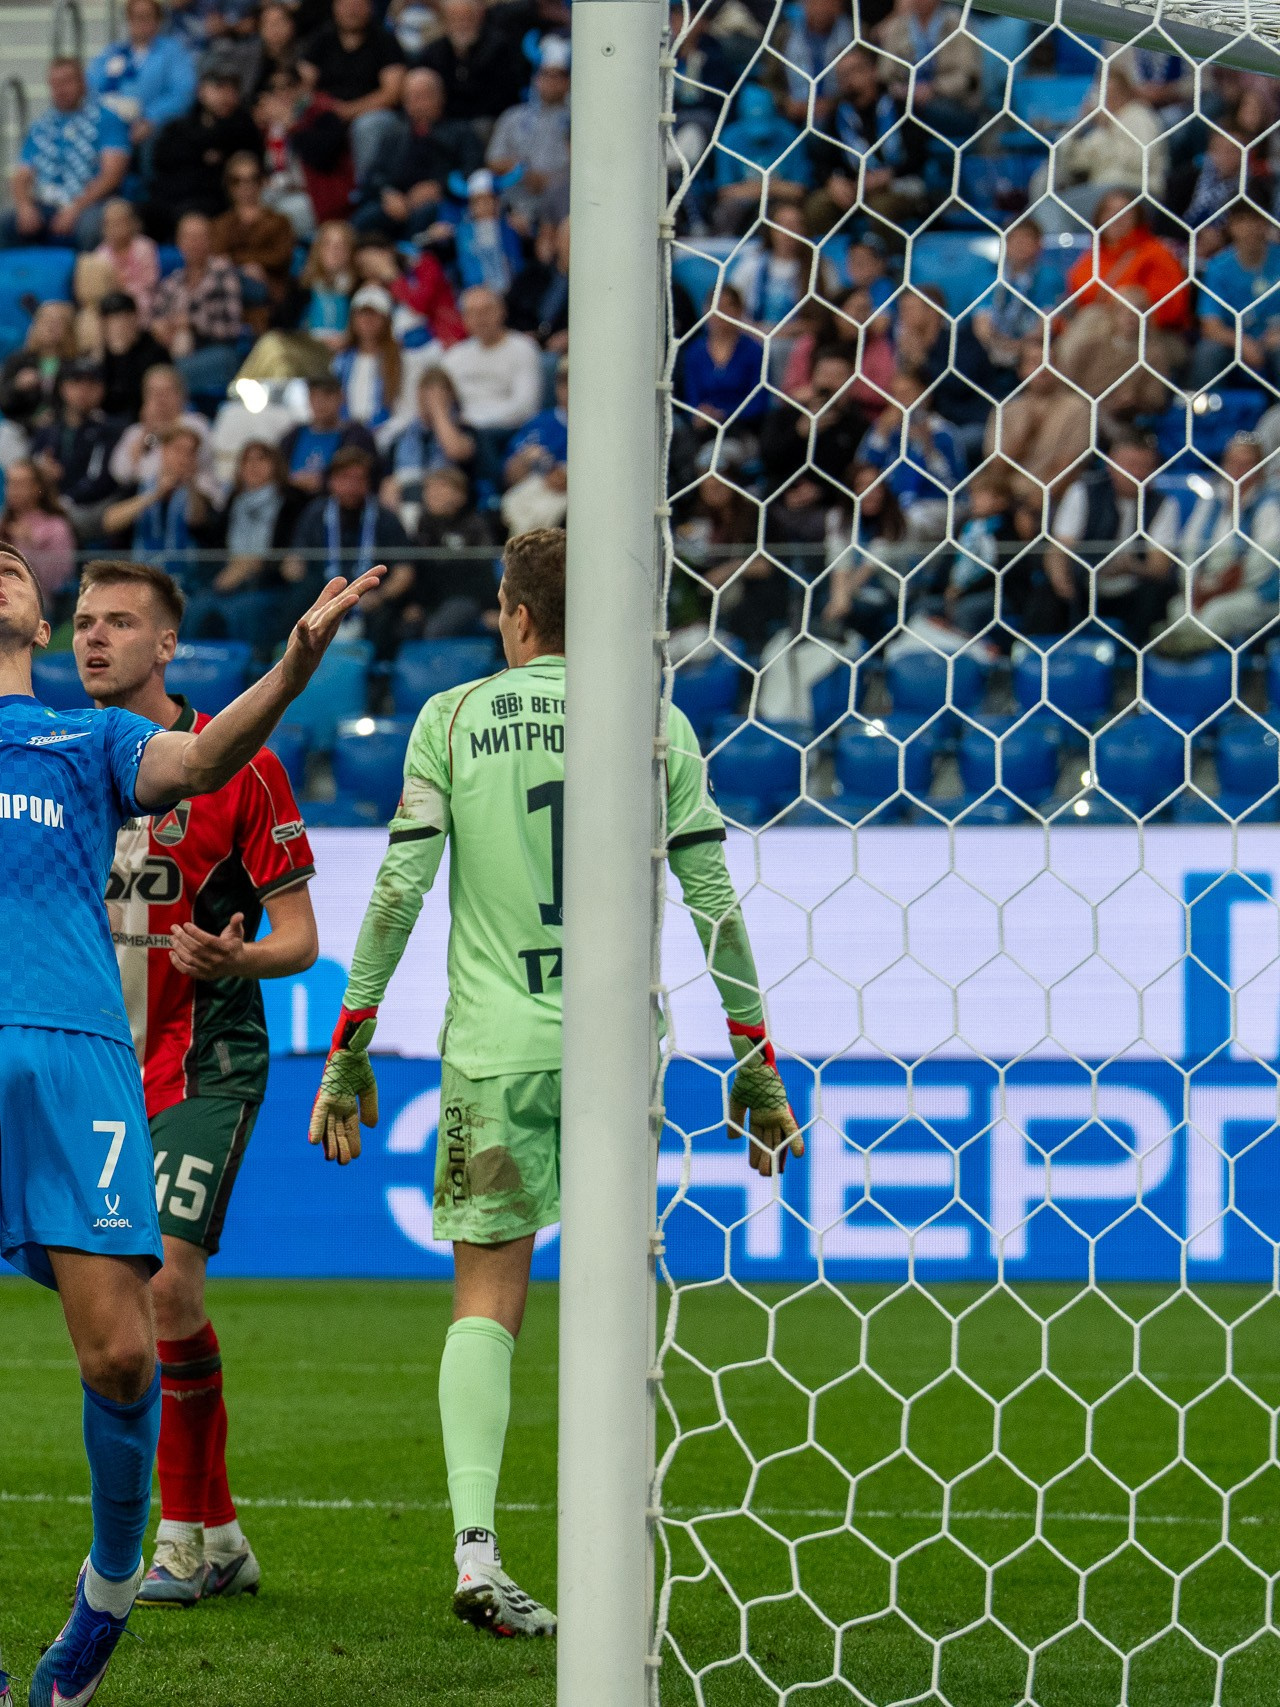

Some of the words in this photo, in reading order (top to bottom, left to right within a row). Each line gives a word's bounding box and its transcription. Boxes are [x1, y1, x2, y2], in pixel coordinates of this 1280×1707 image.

[470, 722, 565, 759] МИТРЮ
[112, 932, 171, 946] ОМБАНК
[92, 1121, 126, 1189] 7
[153, 1150, 214, 1222] 45
[445, 1106, 466, 1206] ТОПАЗ
